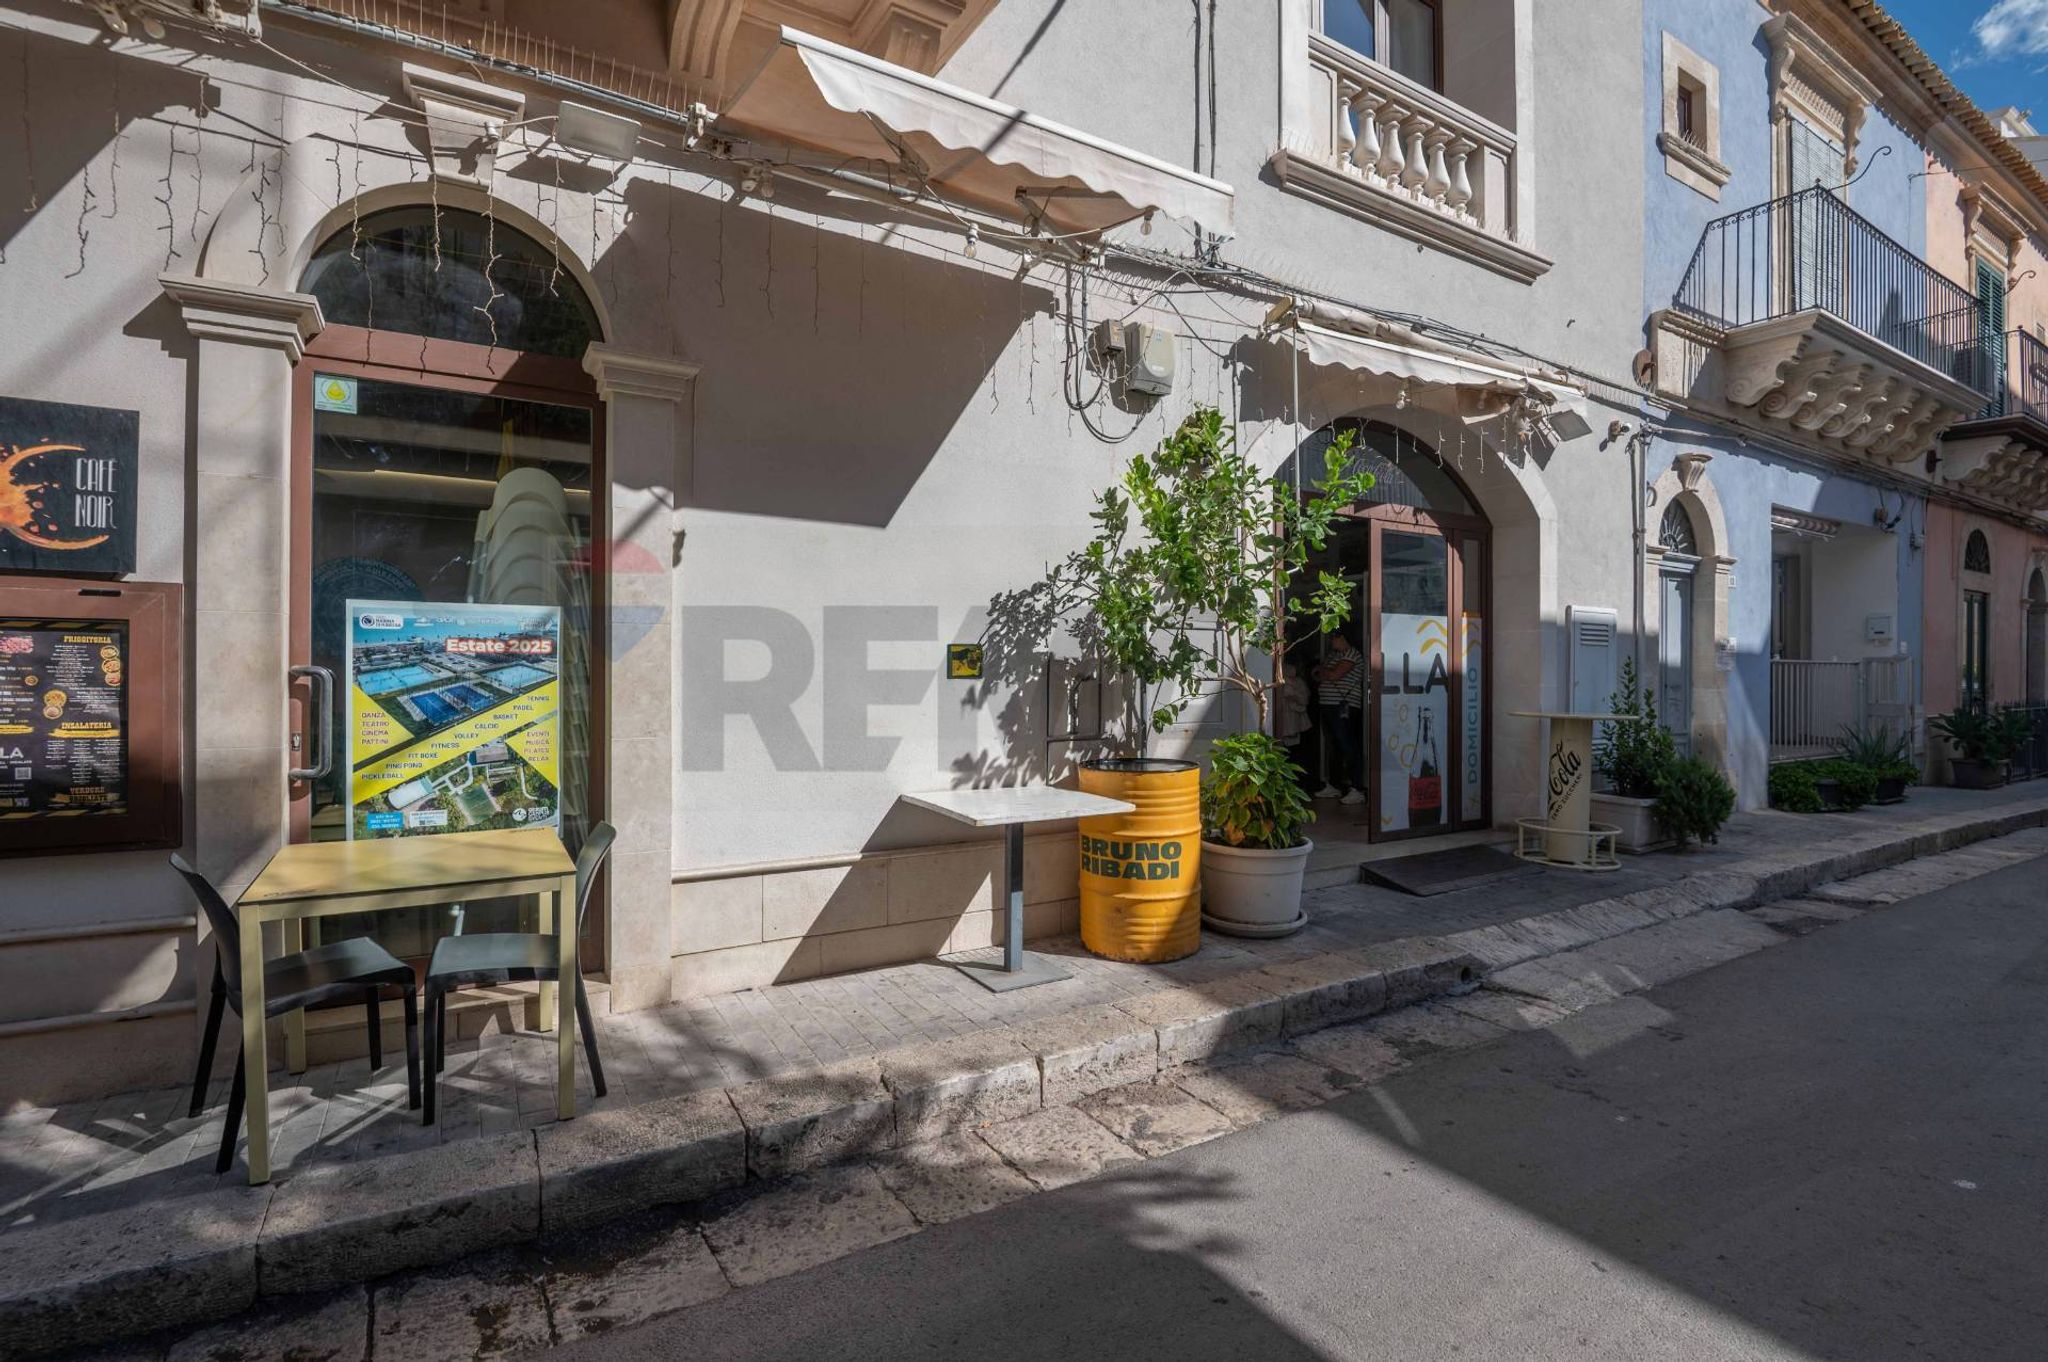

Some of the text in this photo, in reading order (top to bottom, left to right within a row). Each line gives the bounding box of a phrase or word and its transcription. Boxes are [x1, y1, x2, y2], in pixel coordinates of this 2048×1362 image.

[75, 493, 117, 529] NOIR
[446, 638, 552, 653] Estate 2025
[1468, 668, 1477, 784] DOMICILIO
[1081, 835, 1182, 861] BRUNO
[1081, 853, 1180, 881] RIBADI
